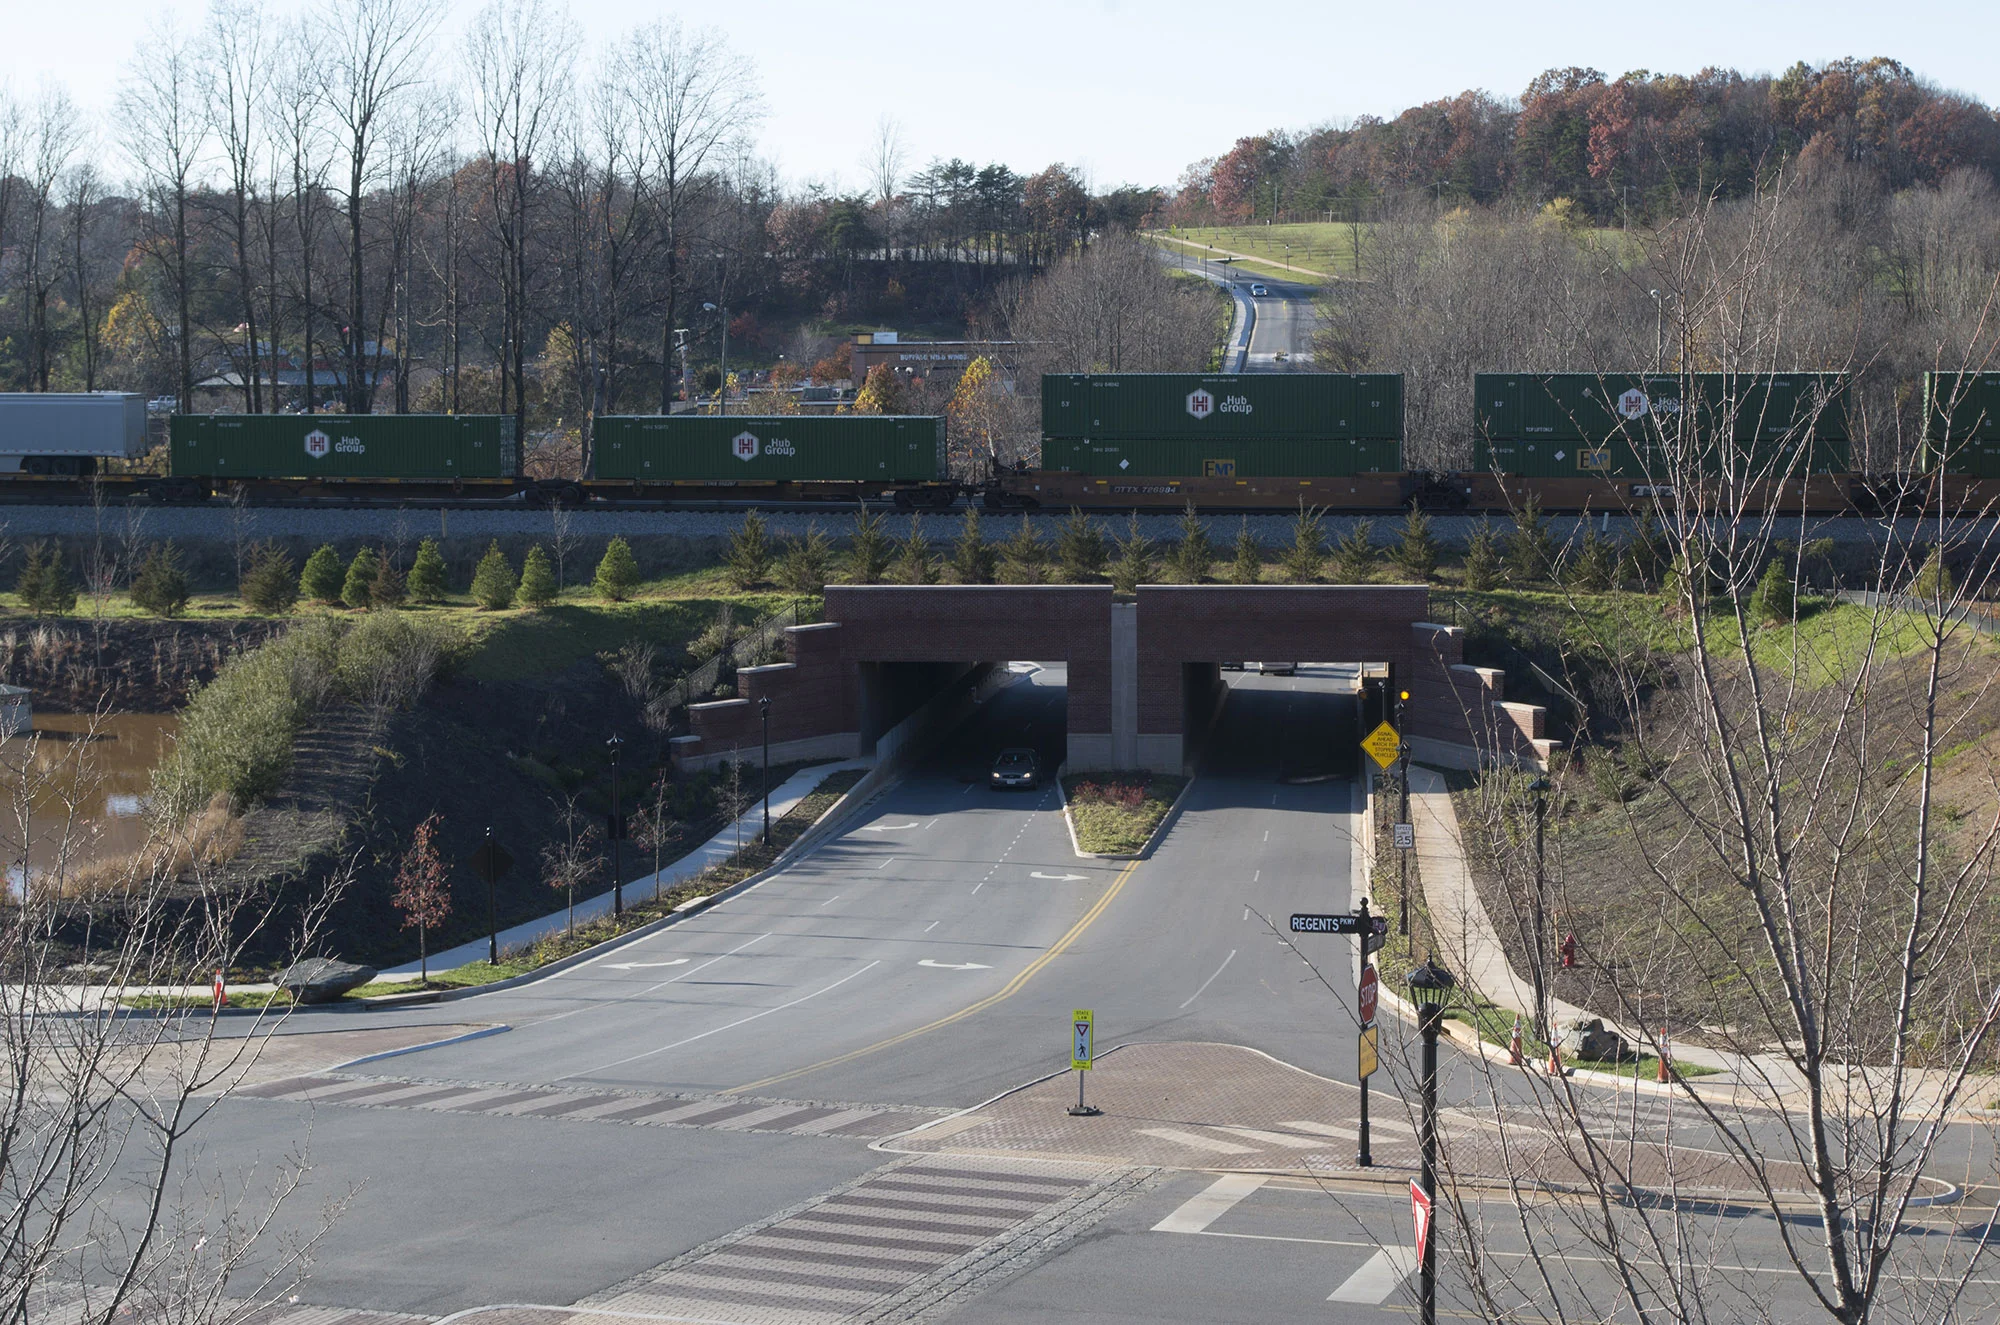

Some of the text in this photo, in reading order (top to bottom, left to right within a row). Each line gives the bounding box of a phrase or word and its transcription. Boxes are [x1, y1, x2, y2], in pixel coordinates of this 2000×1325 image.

[1227, 395, 1247, 405] Hub
[1220, 402, 1253, 415] Group
[341, 436, 360, 445] Hub
[771, 438, 790, 447] Hub
[335, 443, 366, 454] Group
[764, 445, 796, 457] Group
[1396, 835, 1411, 845] 25
[1292, 917, 1356, 932] REGENTS PKWY
[1361, 982, 1376, 1007] STOP
